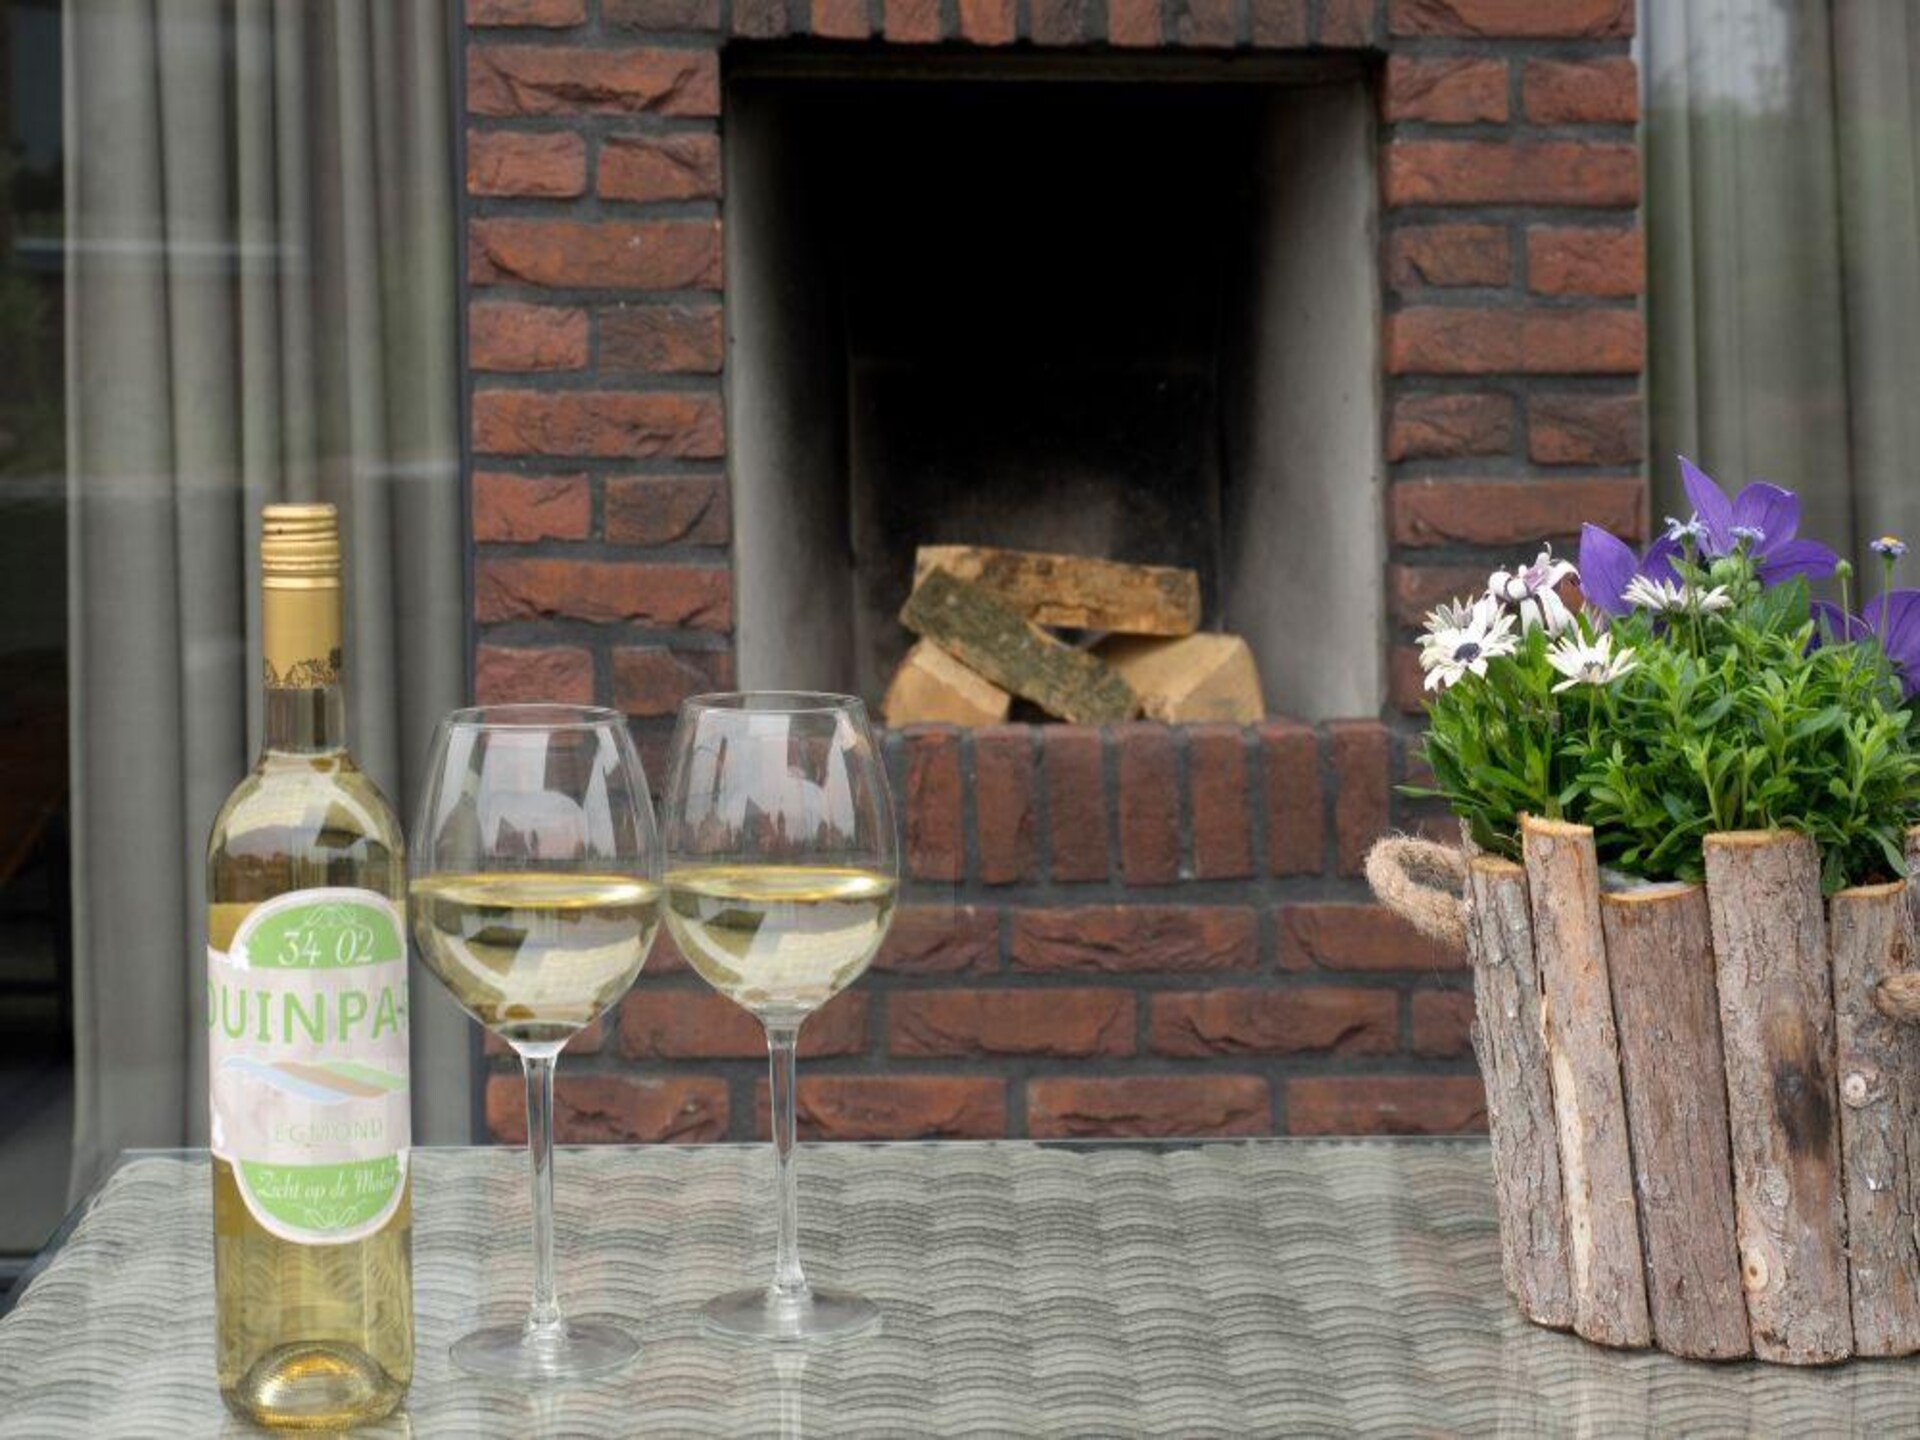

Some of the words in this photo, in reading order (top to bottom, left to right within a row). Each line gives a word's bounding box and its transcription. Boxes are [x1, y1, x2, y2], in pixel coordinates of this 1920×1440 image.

[277, 930, 322, 965] 34
[335, 928, 375, 964] 02
[274, 1117, 385, 1143] EGMOND
[304, 1184, 326, 1206] op
